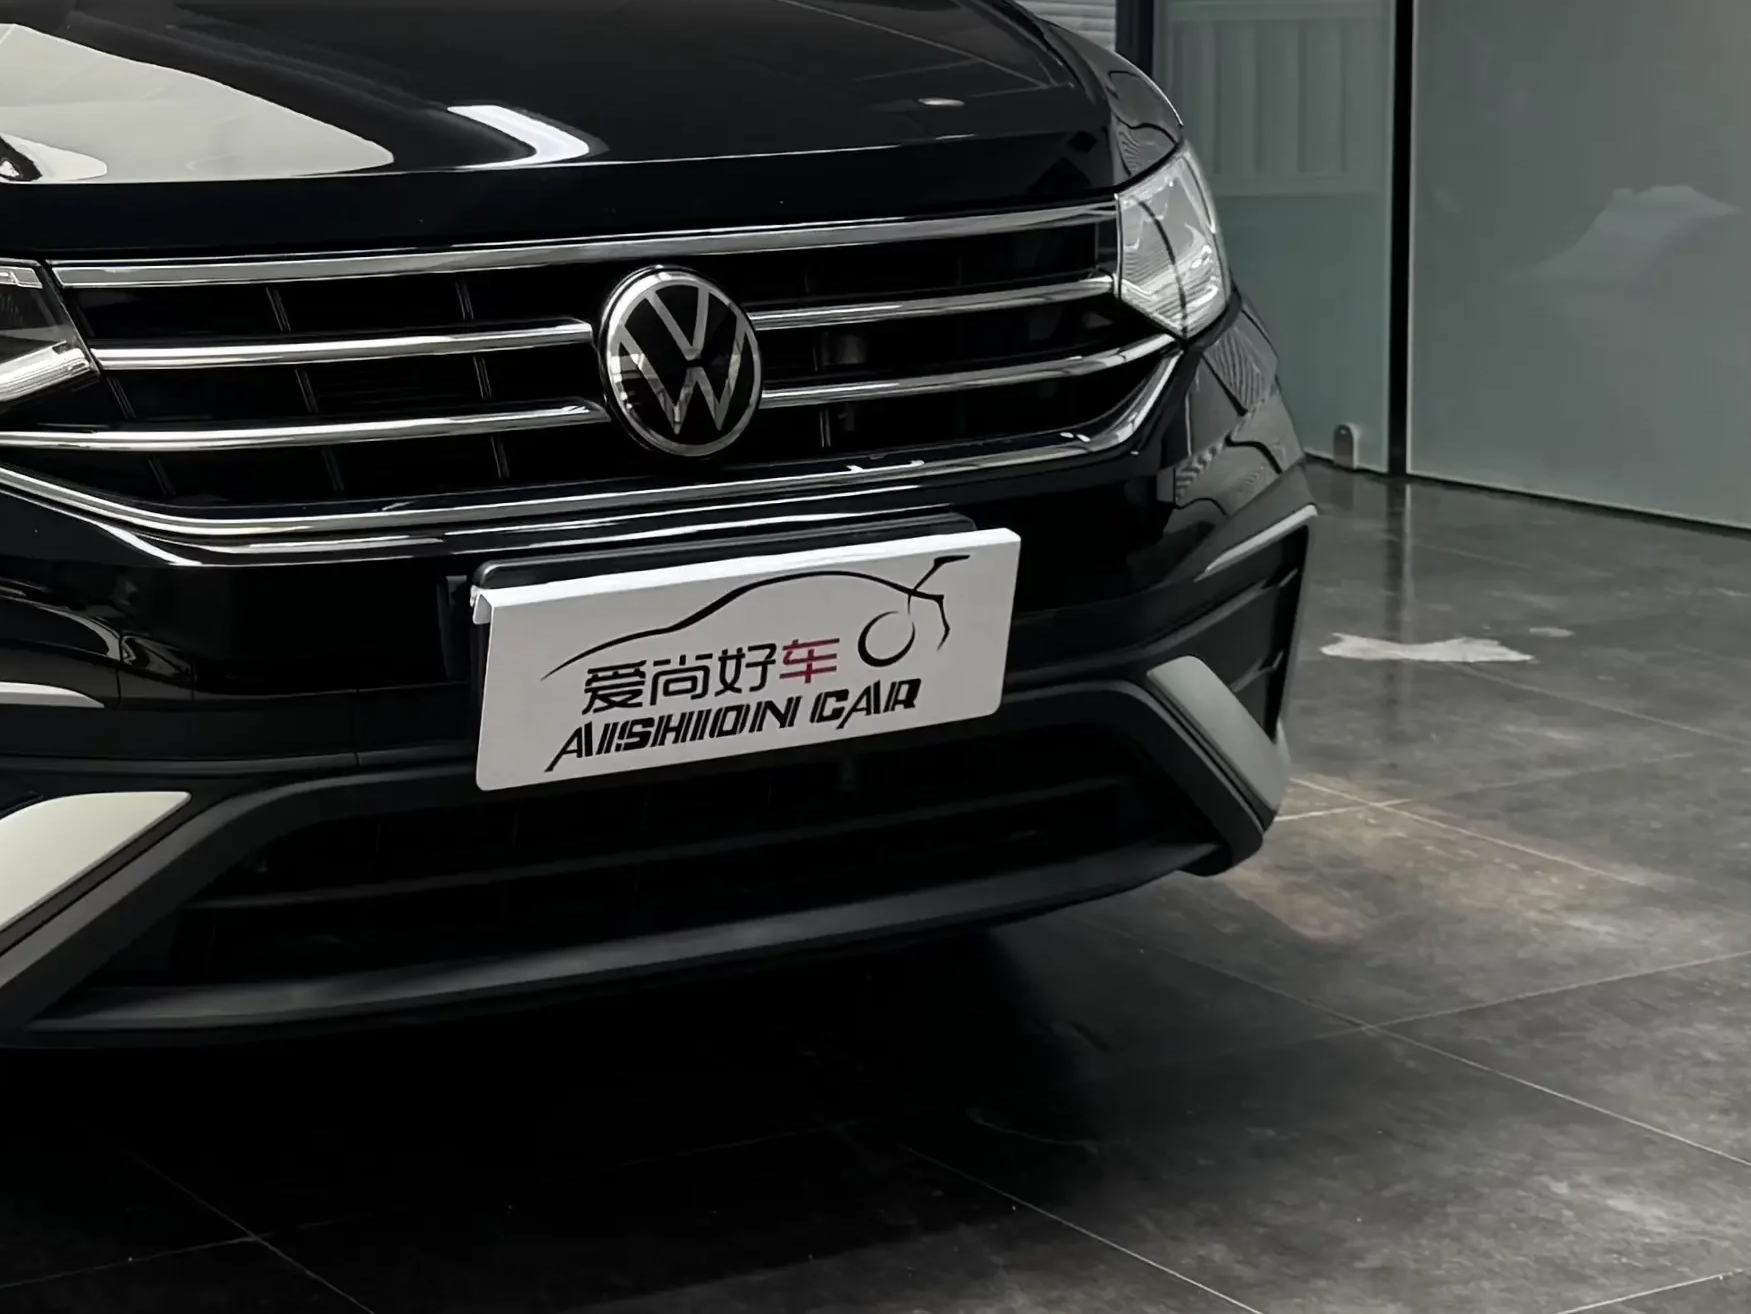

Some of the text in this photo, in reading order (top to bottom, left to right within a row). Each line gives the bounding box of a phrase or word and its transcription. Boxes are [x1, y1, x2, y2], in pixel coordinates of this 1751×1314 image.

[581, 637, 840, 716] 爱尚好车
[544, 677, 923, 773] AISHION CAR
